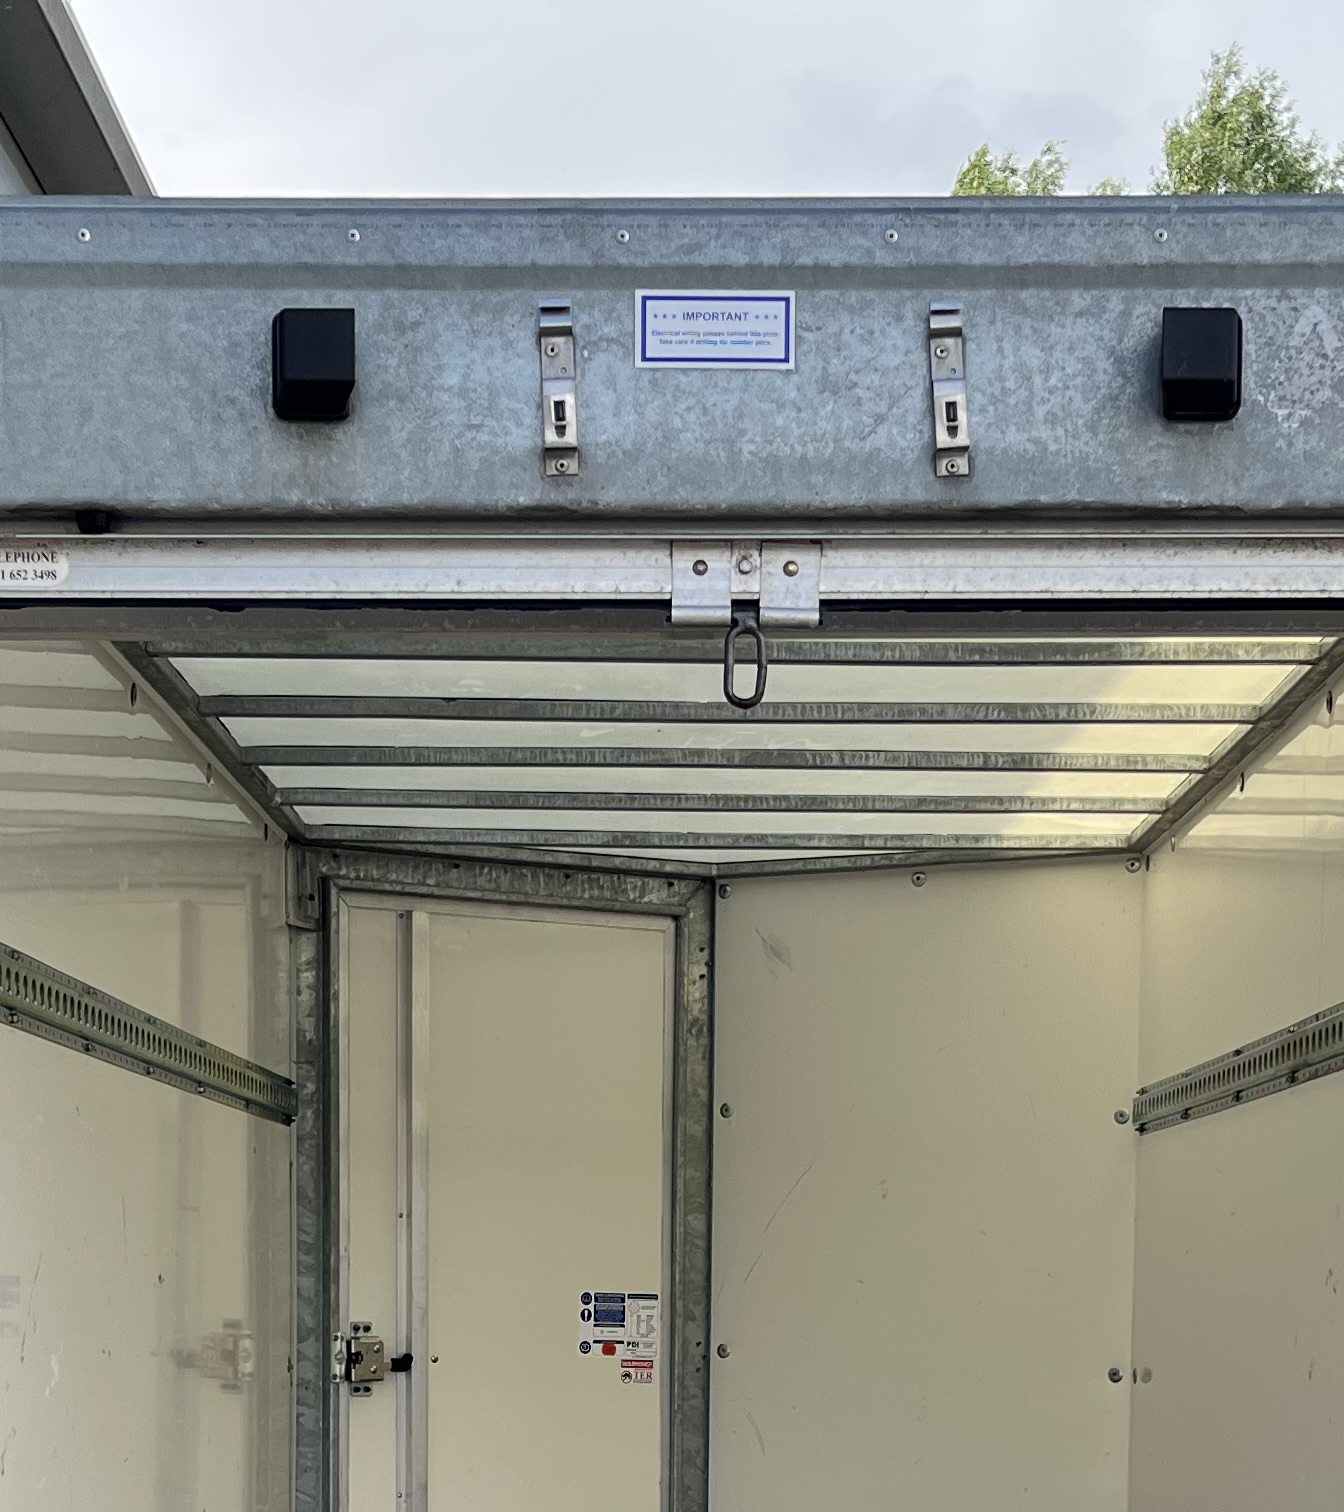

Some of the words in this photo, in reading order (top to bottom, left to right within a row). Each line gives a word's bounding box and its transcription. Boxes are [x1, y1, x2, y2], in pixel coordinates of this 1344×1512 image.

[682, 311, 749, 321] IMPORTANT
[9, 569, 28, 581] 652
[31, 569, 57, 581] 3498
